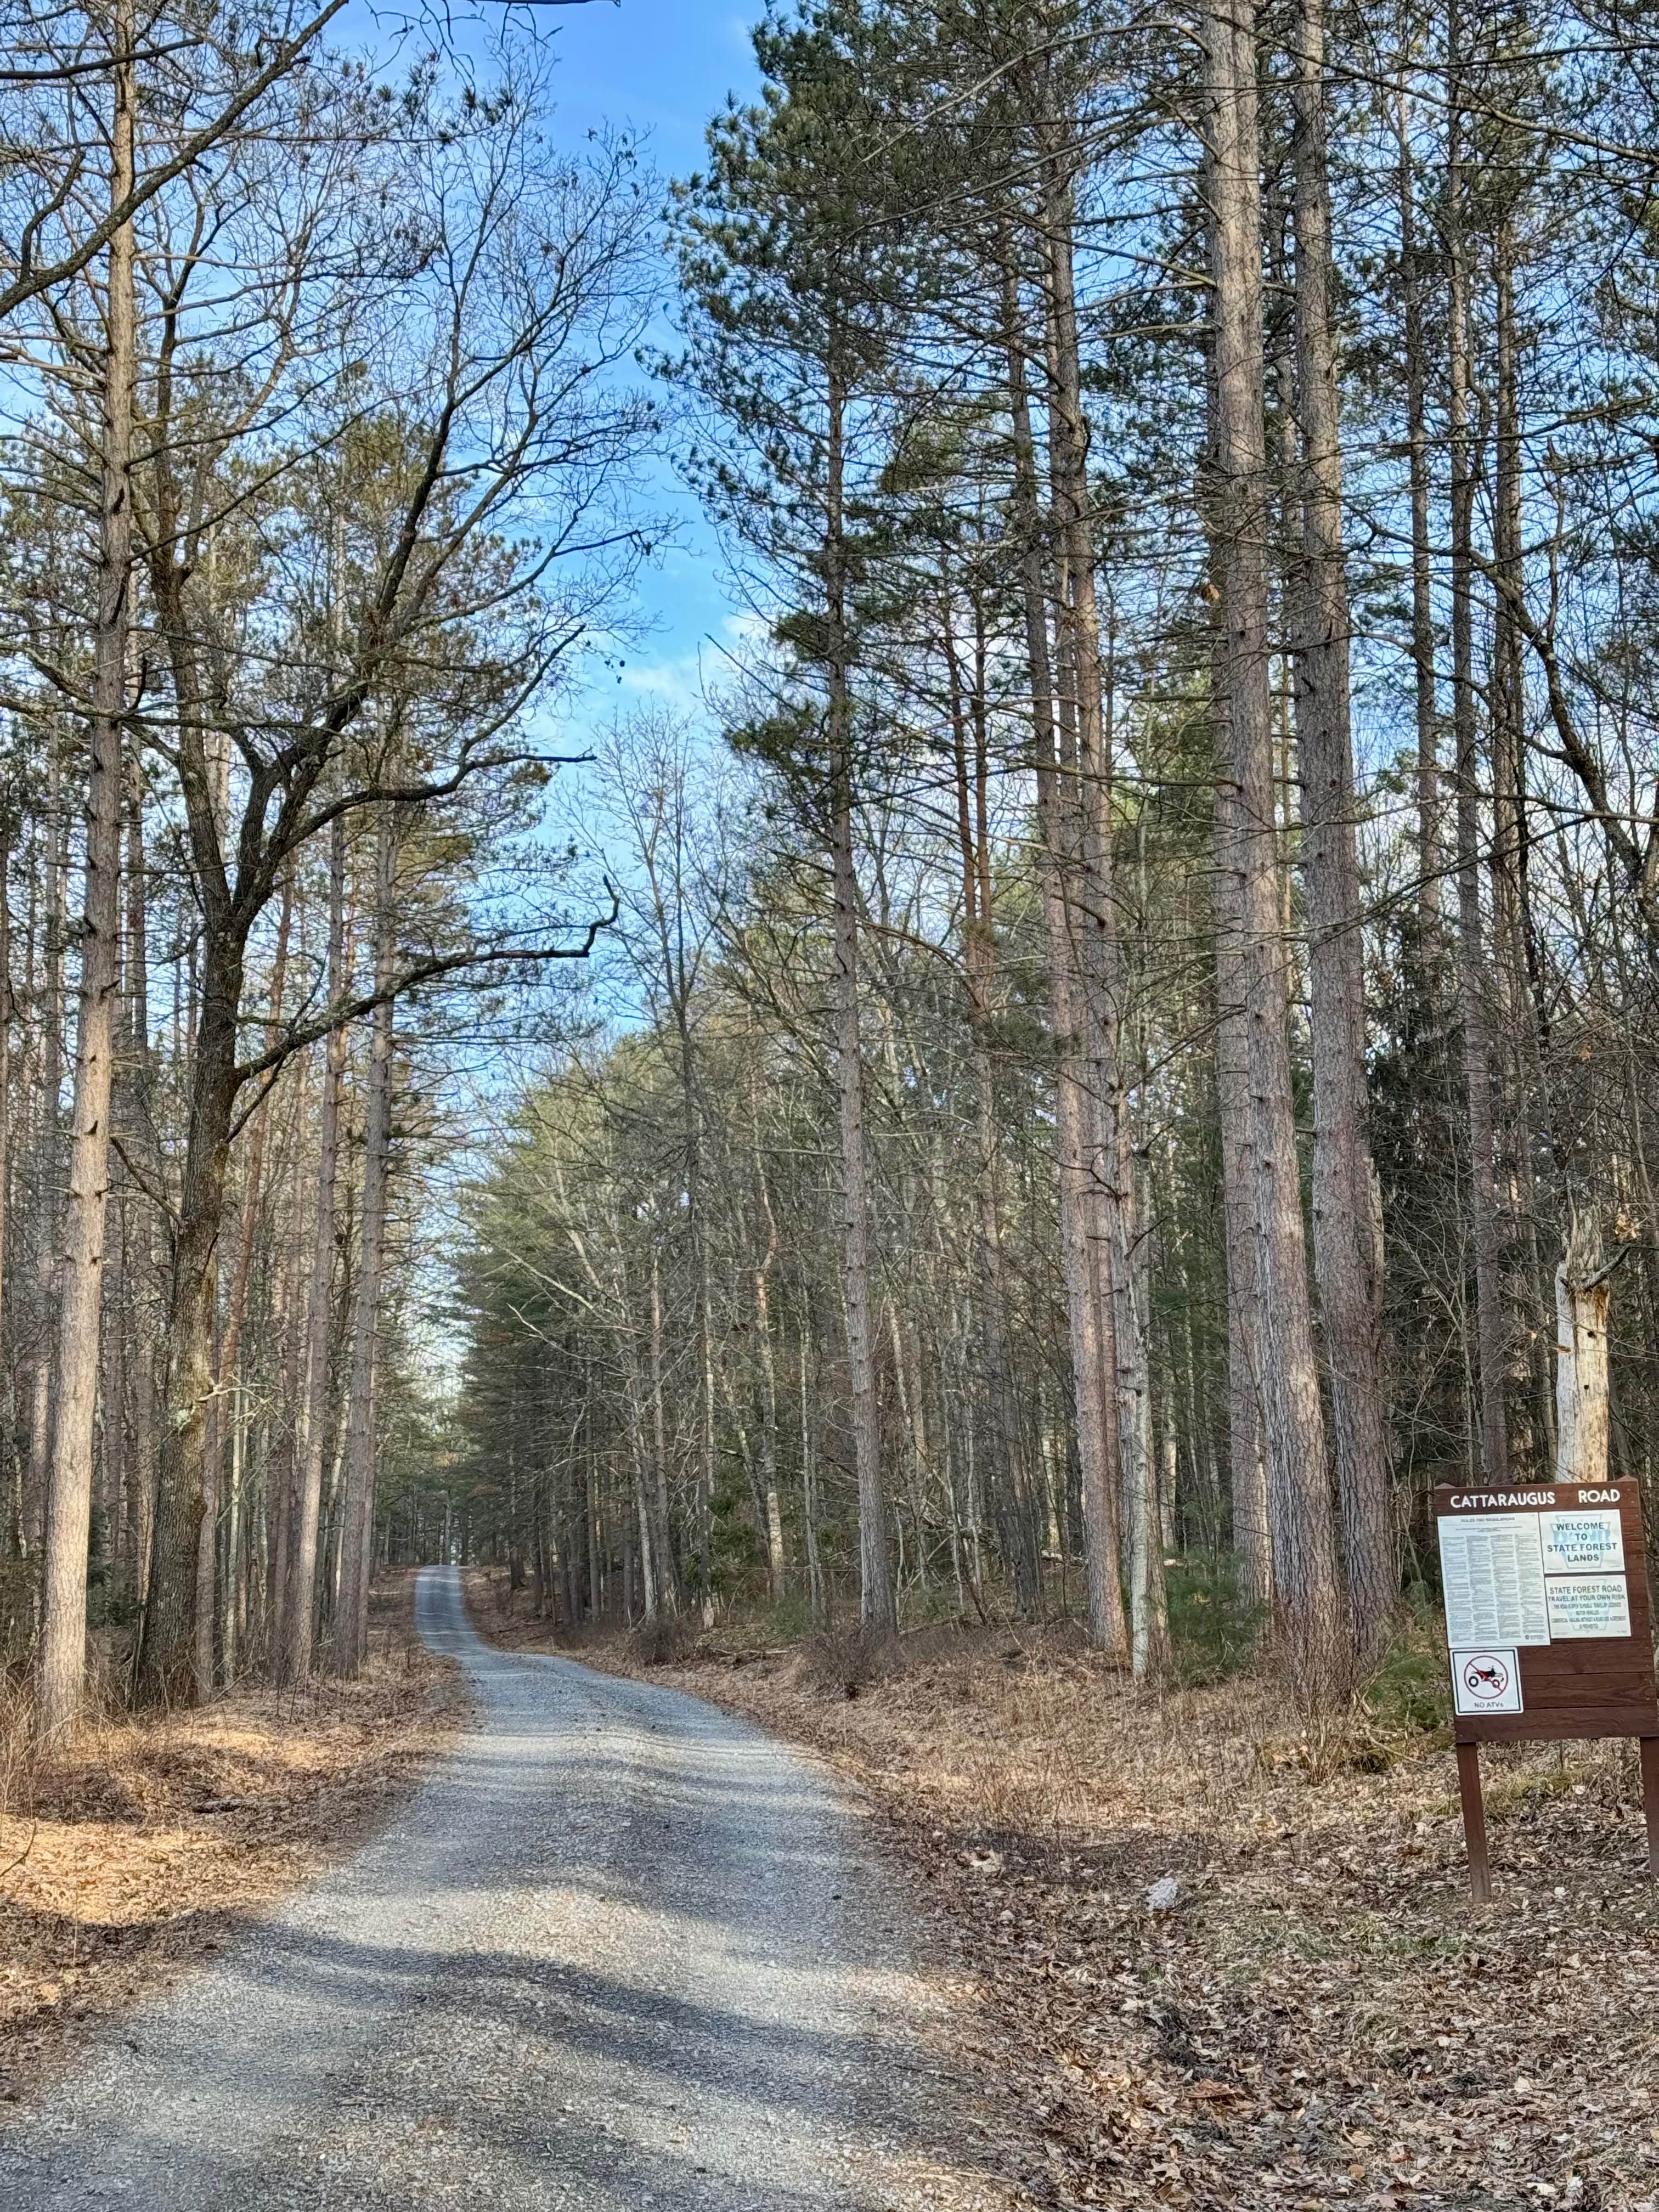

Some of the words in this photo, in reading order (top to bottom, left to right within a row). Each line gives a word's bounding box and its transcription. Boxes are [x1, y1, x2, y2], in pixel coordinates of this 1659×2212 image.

[1450, 1492, 1555, 1508] CATTARAUGUS
[1578, 1489, 1620, 1503] ROAD
[1556, 1522, 1604, 1531] WELCOME
[1547, 1544, 1577, 1552] STATE
[1581, 1543, 1617, 1551] FOREST
